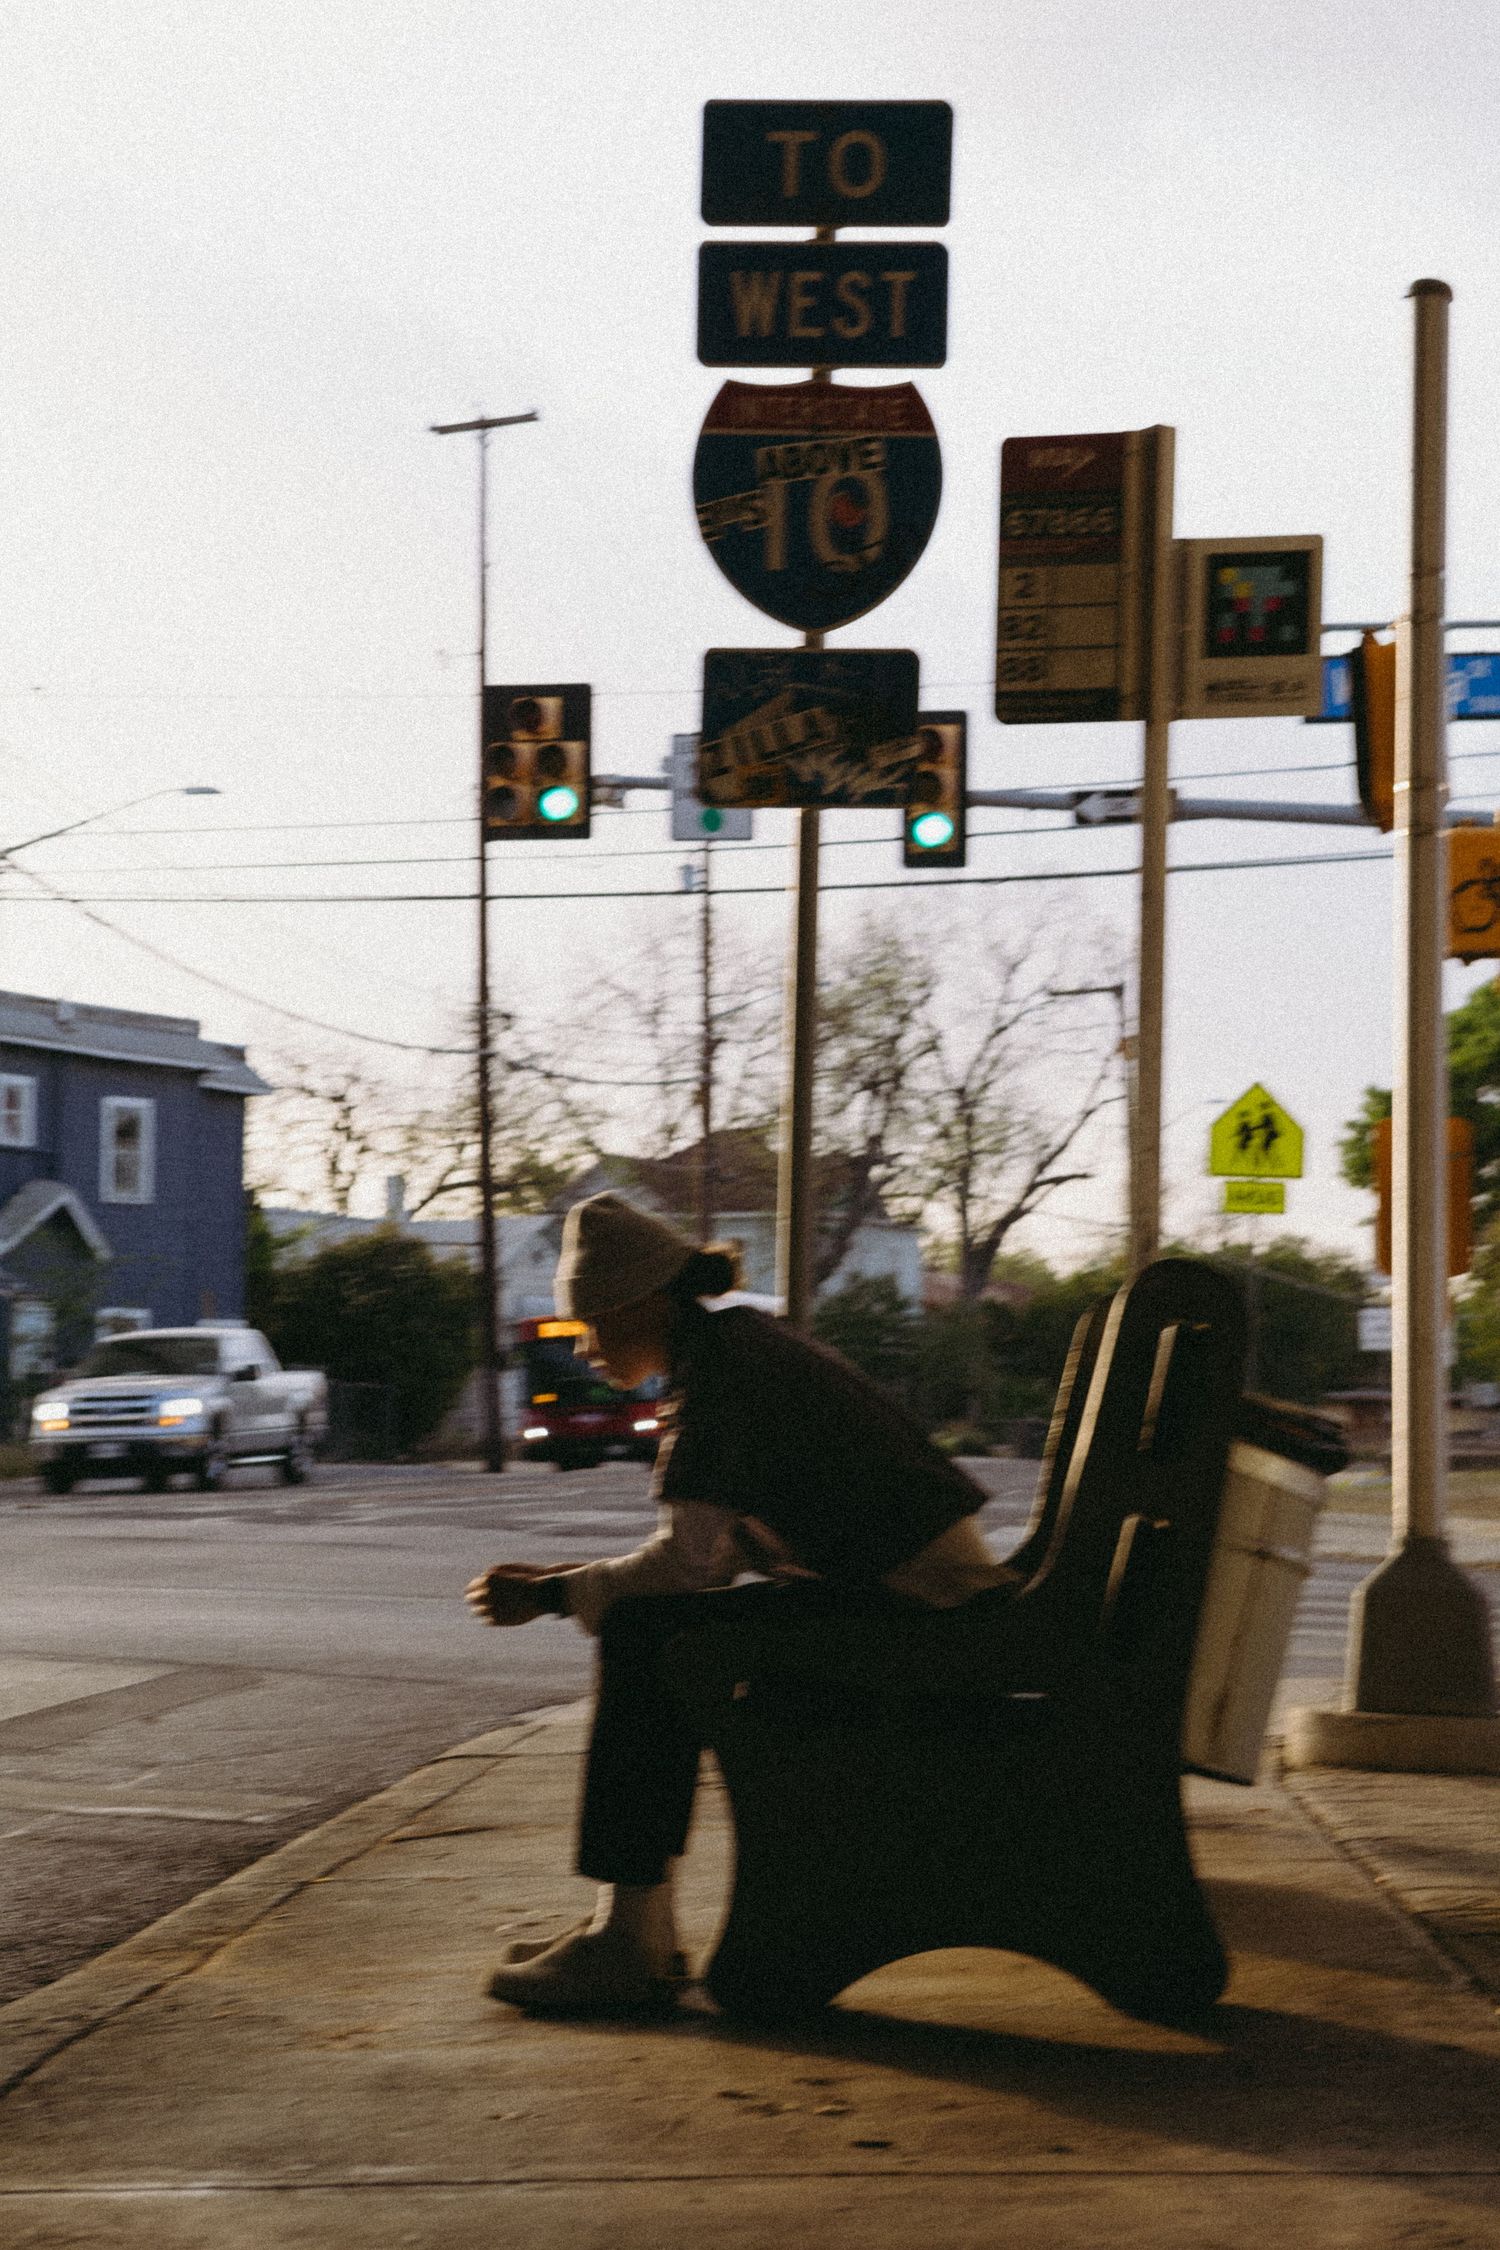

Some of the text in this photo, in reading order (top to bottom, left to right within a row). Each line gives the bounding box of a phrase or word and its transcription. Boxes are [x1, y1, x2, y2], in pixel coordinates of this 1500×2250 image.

[765, 129, 887, 198] TO
[730, 270, 917, 338] WEST
[762, 470, 889, 572] 10
